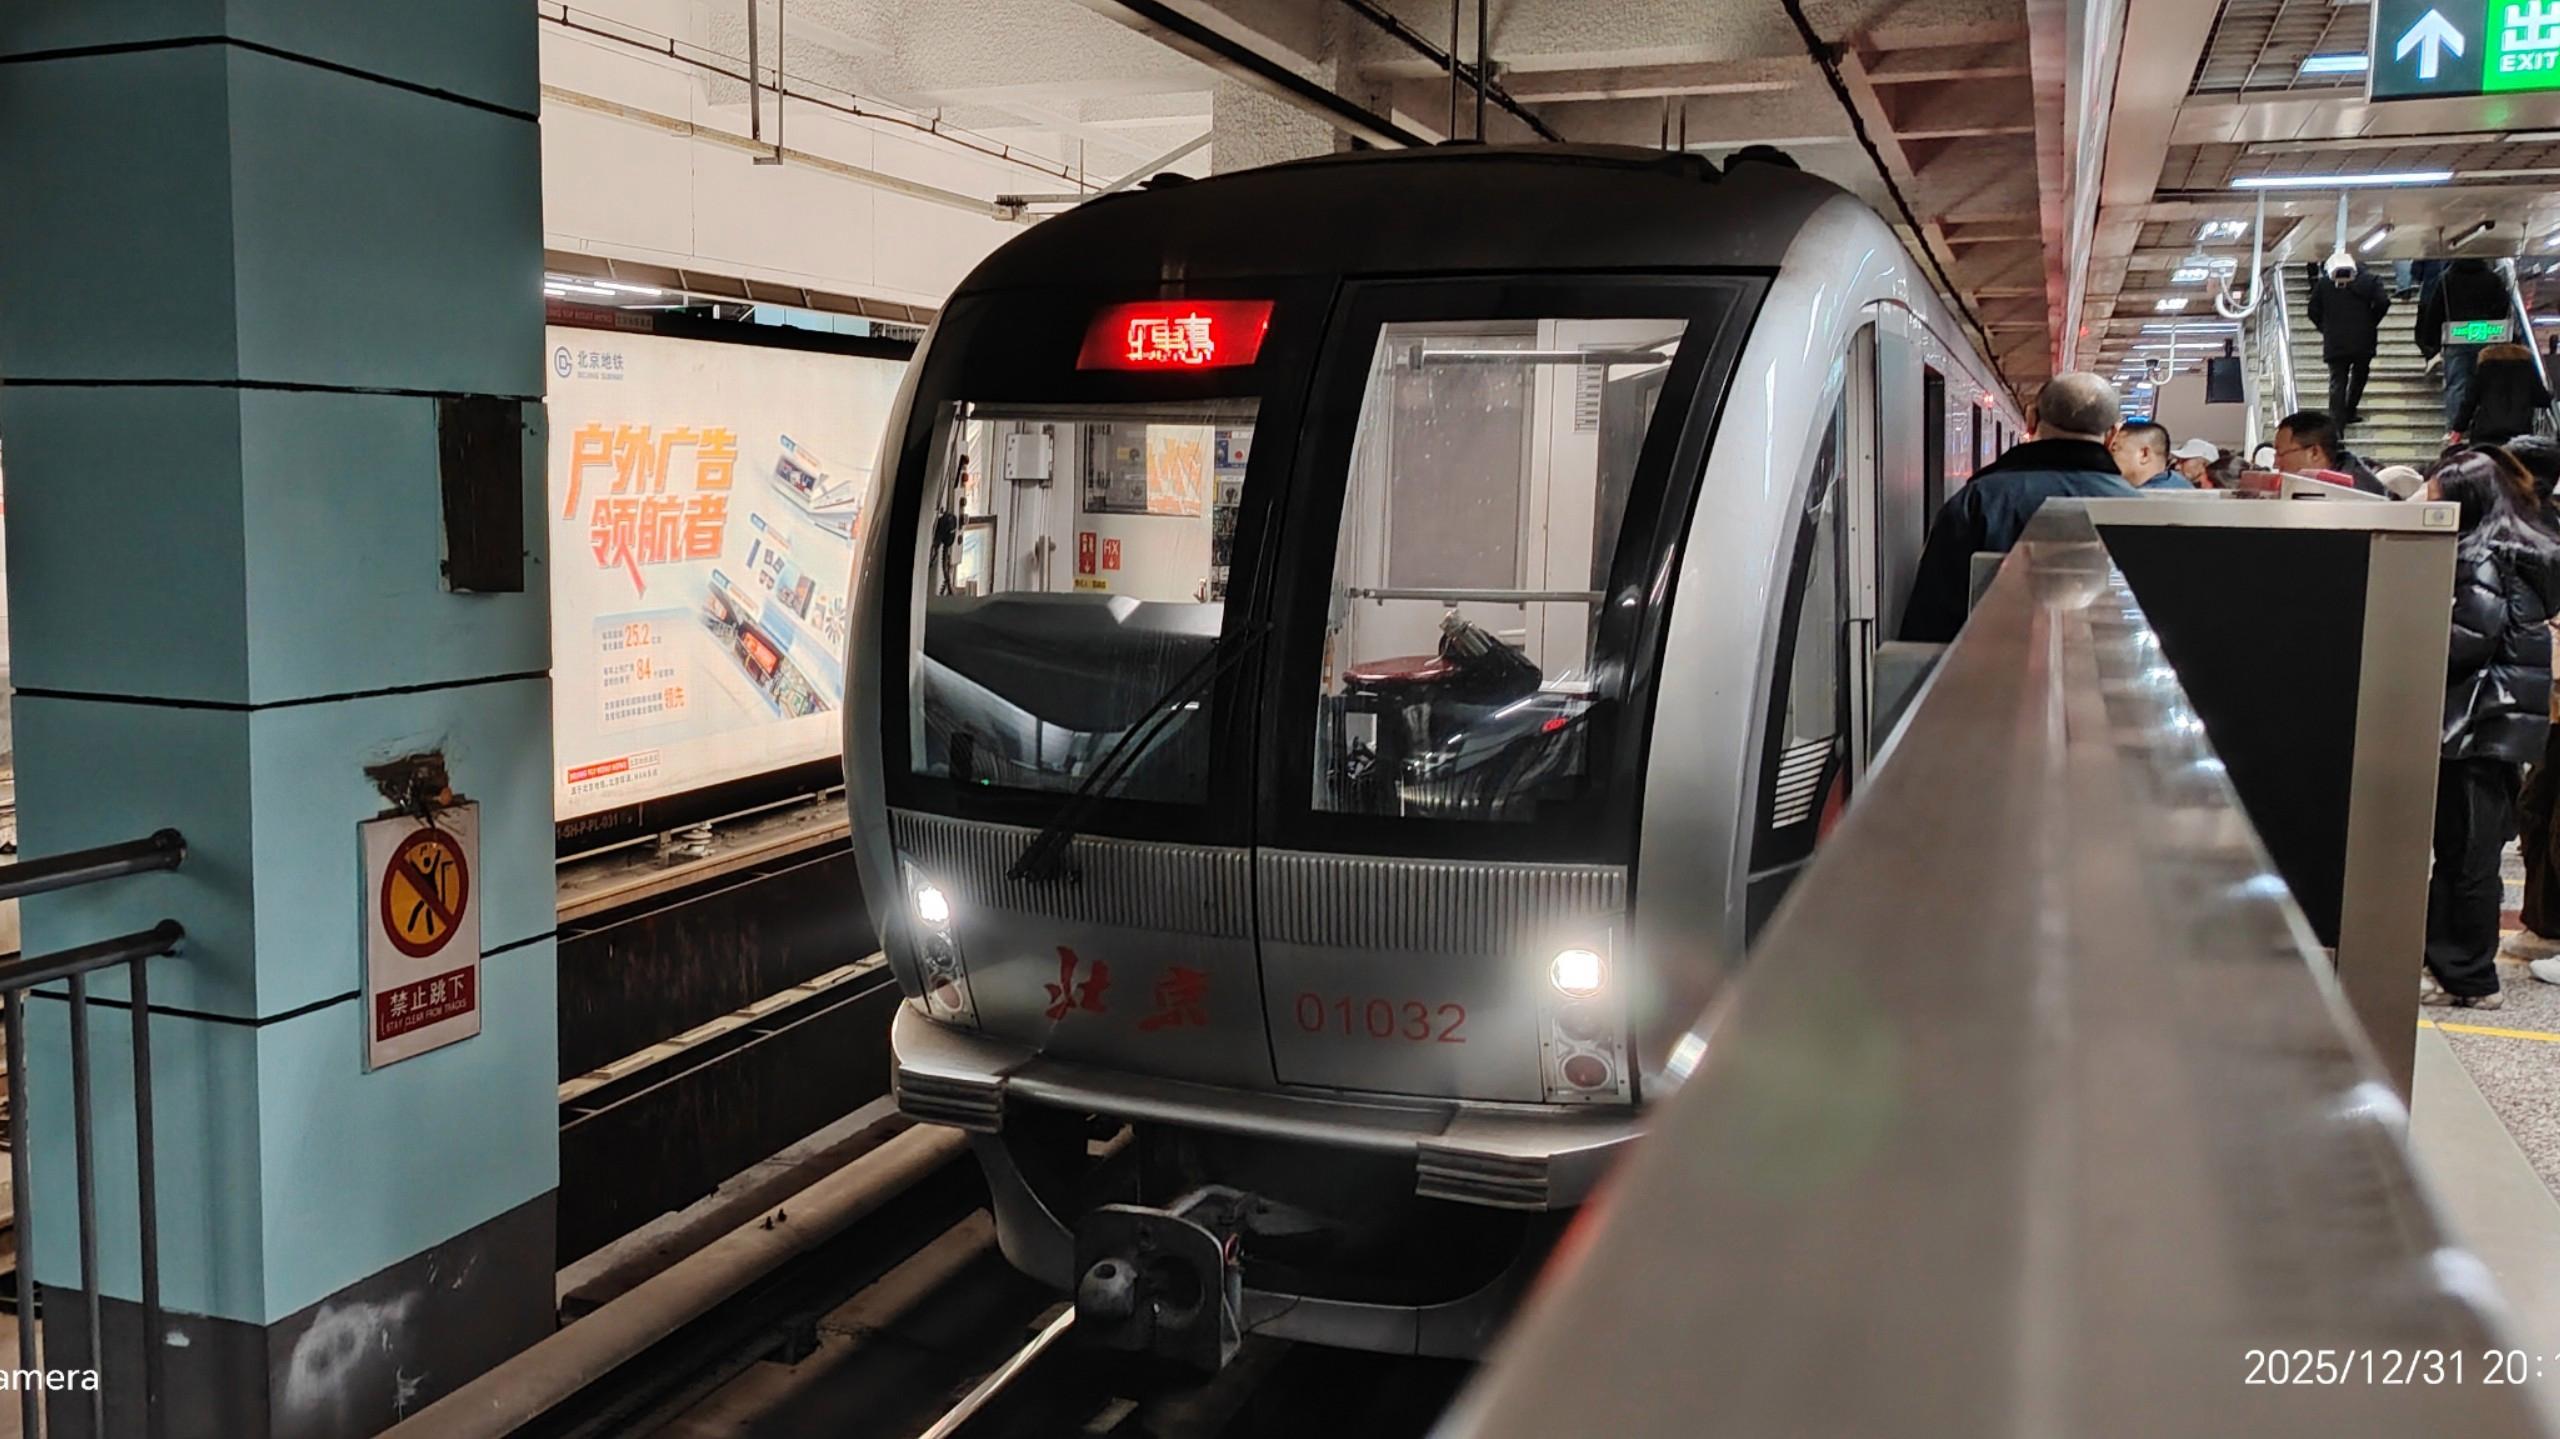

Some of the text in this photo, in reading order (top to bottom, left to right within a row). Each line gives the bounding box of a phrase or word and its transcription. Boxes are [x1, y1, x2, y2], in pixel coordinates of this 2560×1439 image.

[2500, 50, 2560, 73] EXIT
[577, 350, 624, 370] 北京地铁
[562, 423, 738, 521] 户外广告
[590, 493, 728, 598] 领航者
[624, 623, 650, 648] 25.2
[636, 657, 652, 681] 84
[390, 973, 465, 1017] 禁止跳下
[1044, 946, 1212, 1032] 北京
[386, 998, 467, 1032] STAY CLEAR FROM TRACKS
[1298, 993, 1467, 1043] 01032
